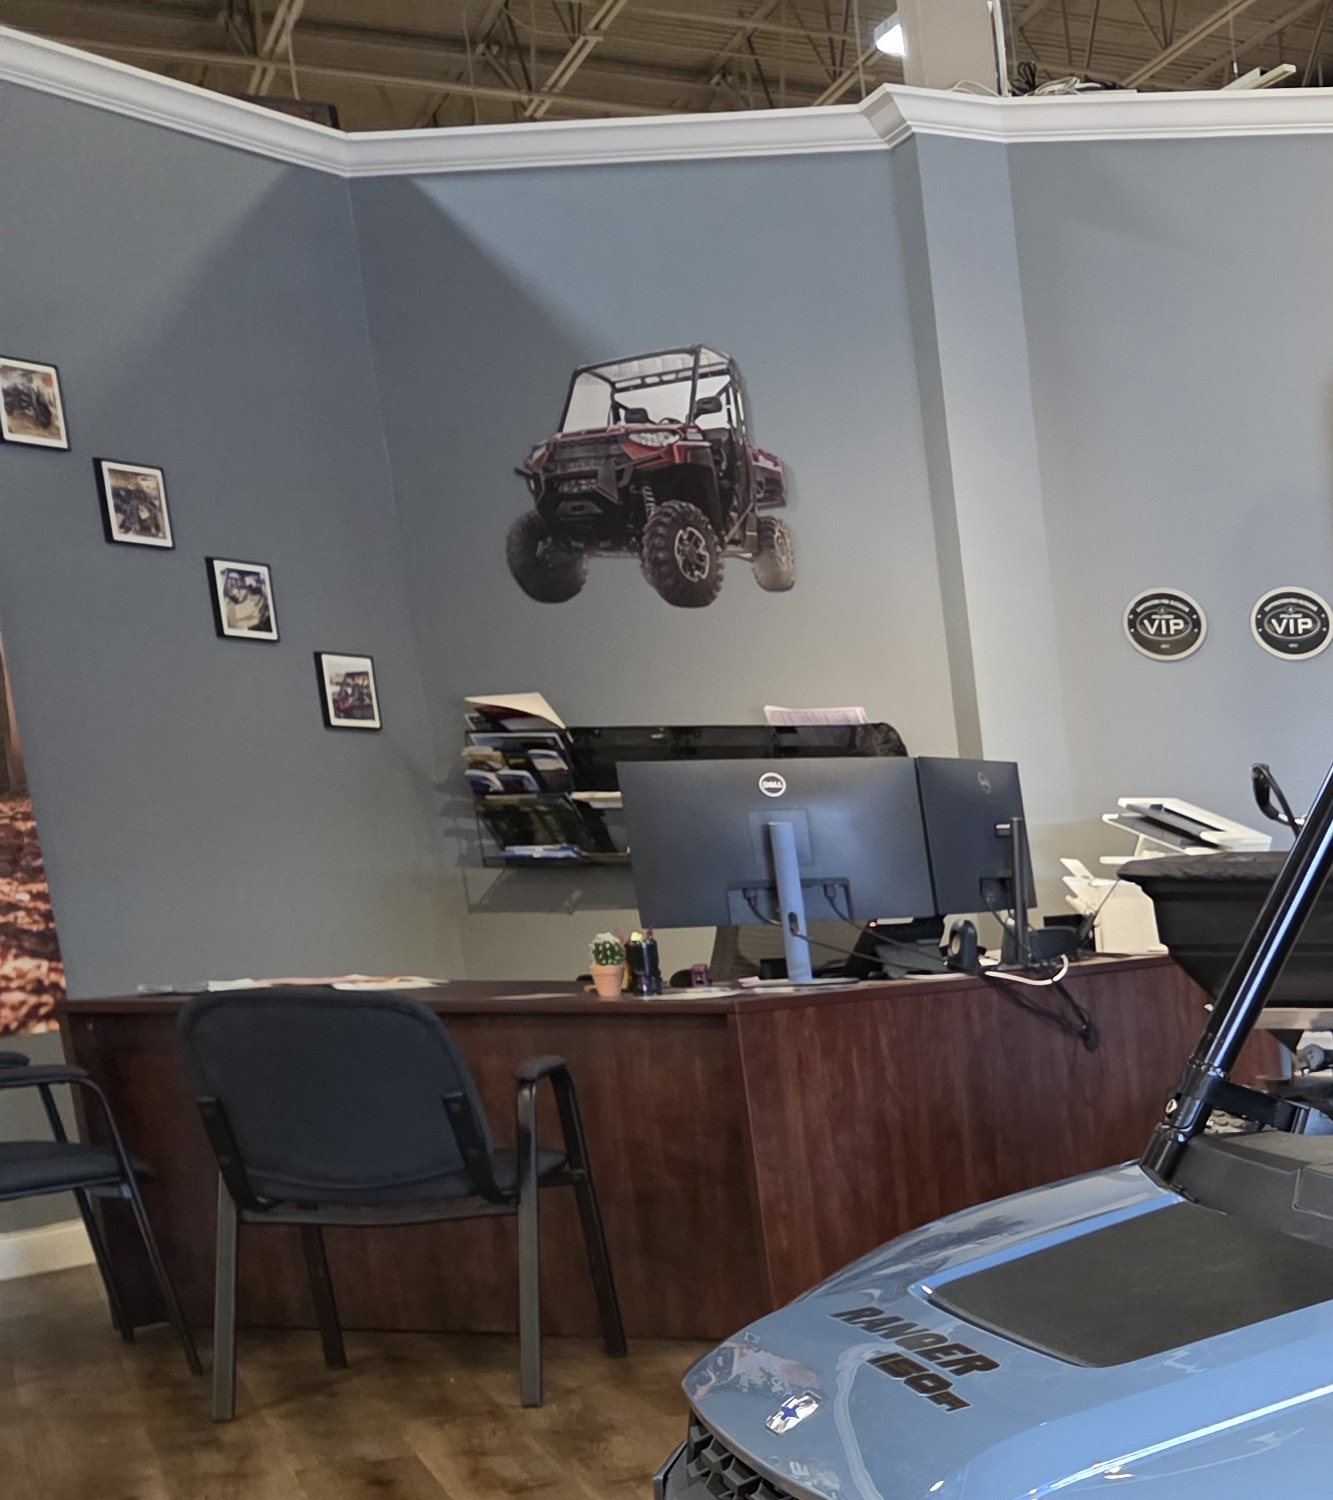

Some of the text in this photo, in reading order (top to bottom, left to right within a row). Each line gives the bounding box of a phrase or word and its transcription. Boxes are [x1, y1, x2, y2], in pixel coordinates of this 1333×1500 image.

[1143, 619, 1185, 635] VIP
[1271, 618, 1313, 634] VIP
[829, 1305, 1001, 1377] RANGER
[864, 1351, 954, 1396] 150
